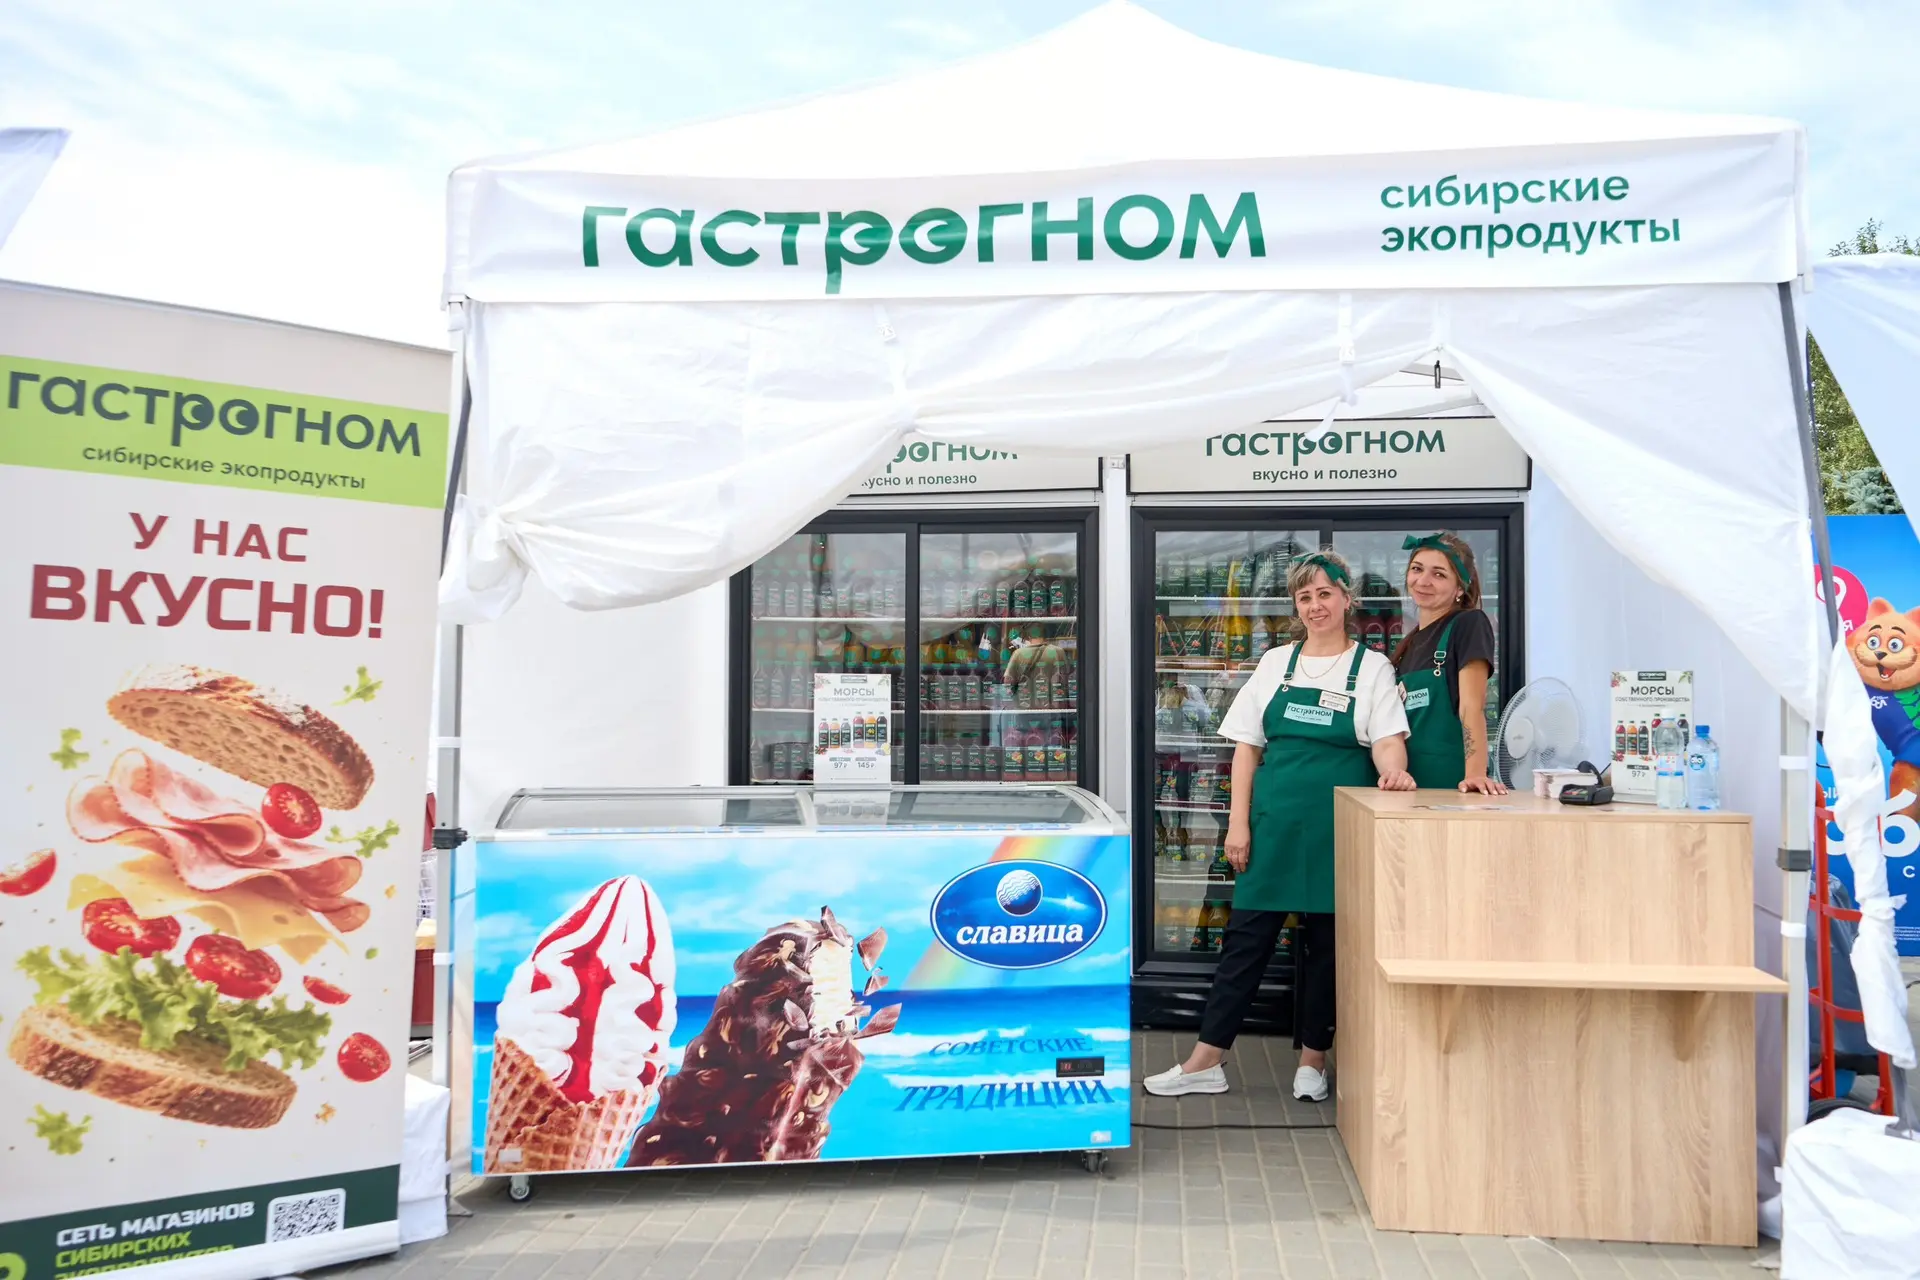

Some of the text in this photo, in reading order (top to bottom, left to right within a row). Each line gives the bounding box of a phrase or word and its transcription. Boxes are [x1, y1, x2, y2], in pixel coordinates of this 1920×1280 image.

[1380, 174, 1630, 213] сибирские
[1380, 218, 1680, 258] экопродукты
[82, 445, 366, 489] сибирские экопродукты
[861, 474, 977, 489] усно и полезно
[1252, 468, 1398, 483] вкусно и полезно
[129, 512, 309, 562] У НАС
[30, 564, 385, 639] ВКУСНО!
[833, 688, 875, 696] МОРСЫ
[1630, 686, 1675, 695] МОРСЫ
[956, 923, 1083, 945] славица
[929, 1037, 1093, 1057] СОВЕТСКИЕ
[892, 1079, 1116, 1112] ТРАДИЦИИ
[56, 1201, 255, 1247] СЕТЬ МАГАЗИНОВ
[55, 1231, 192, 1268] СИБИРСКИХ
